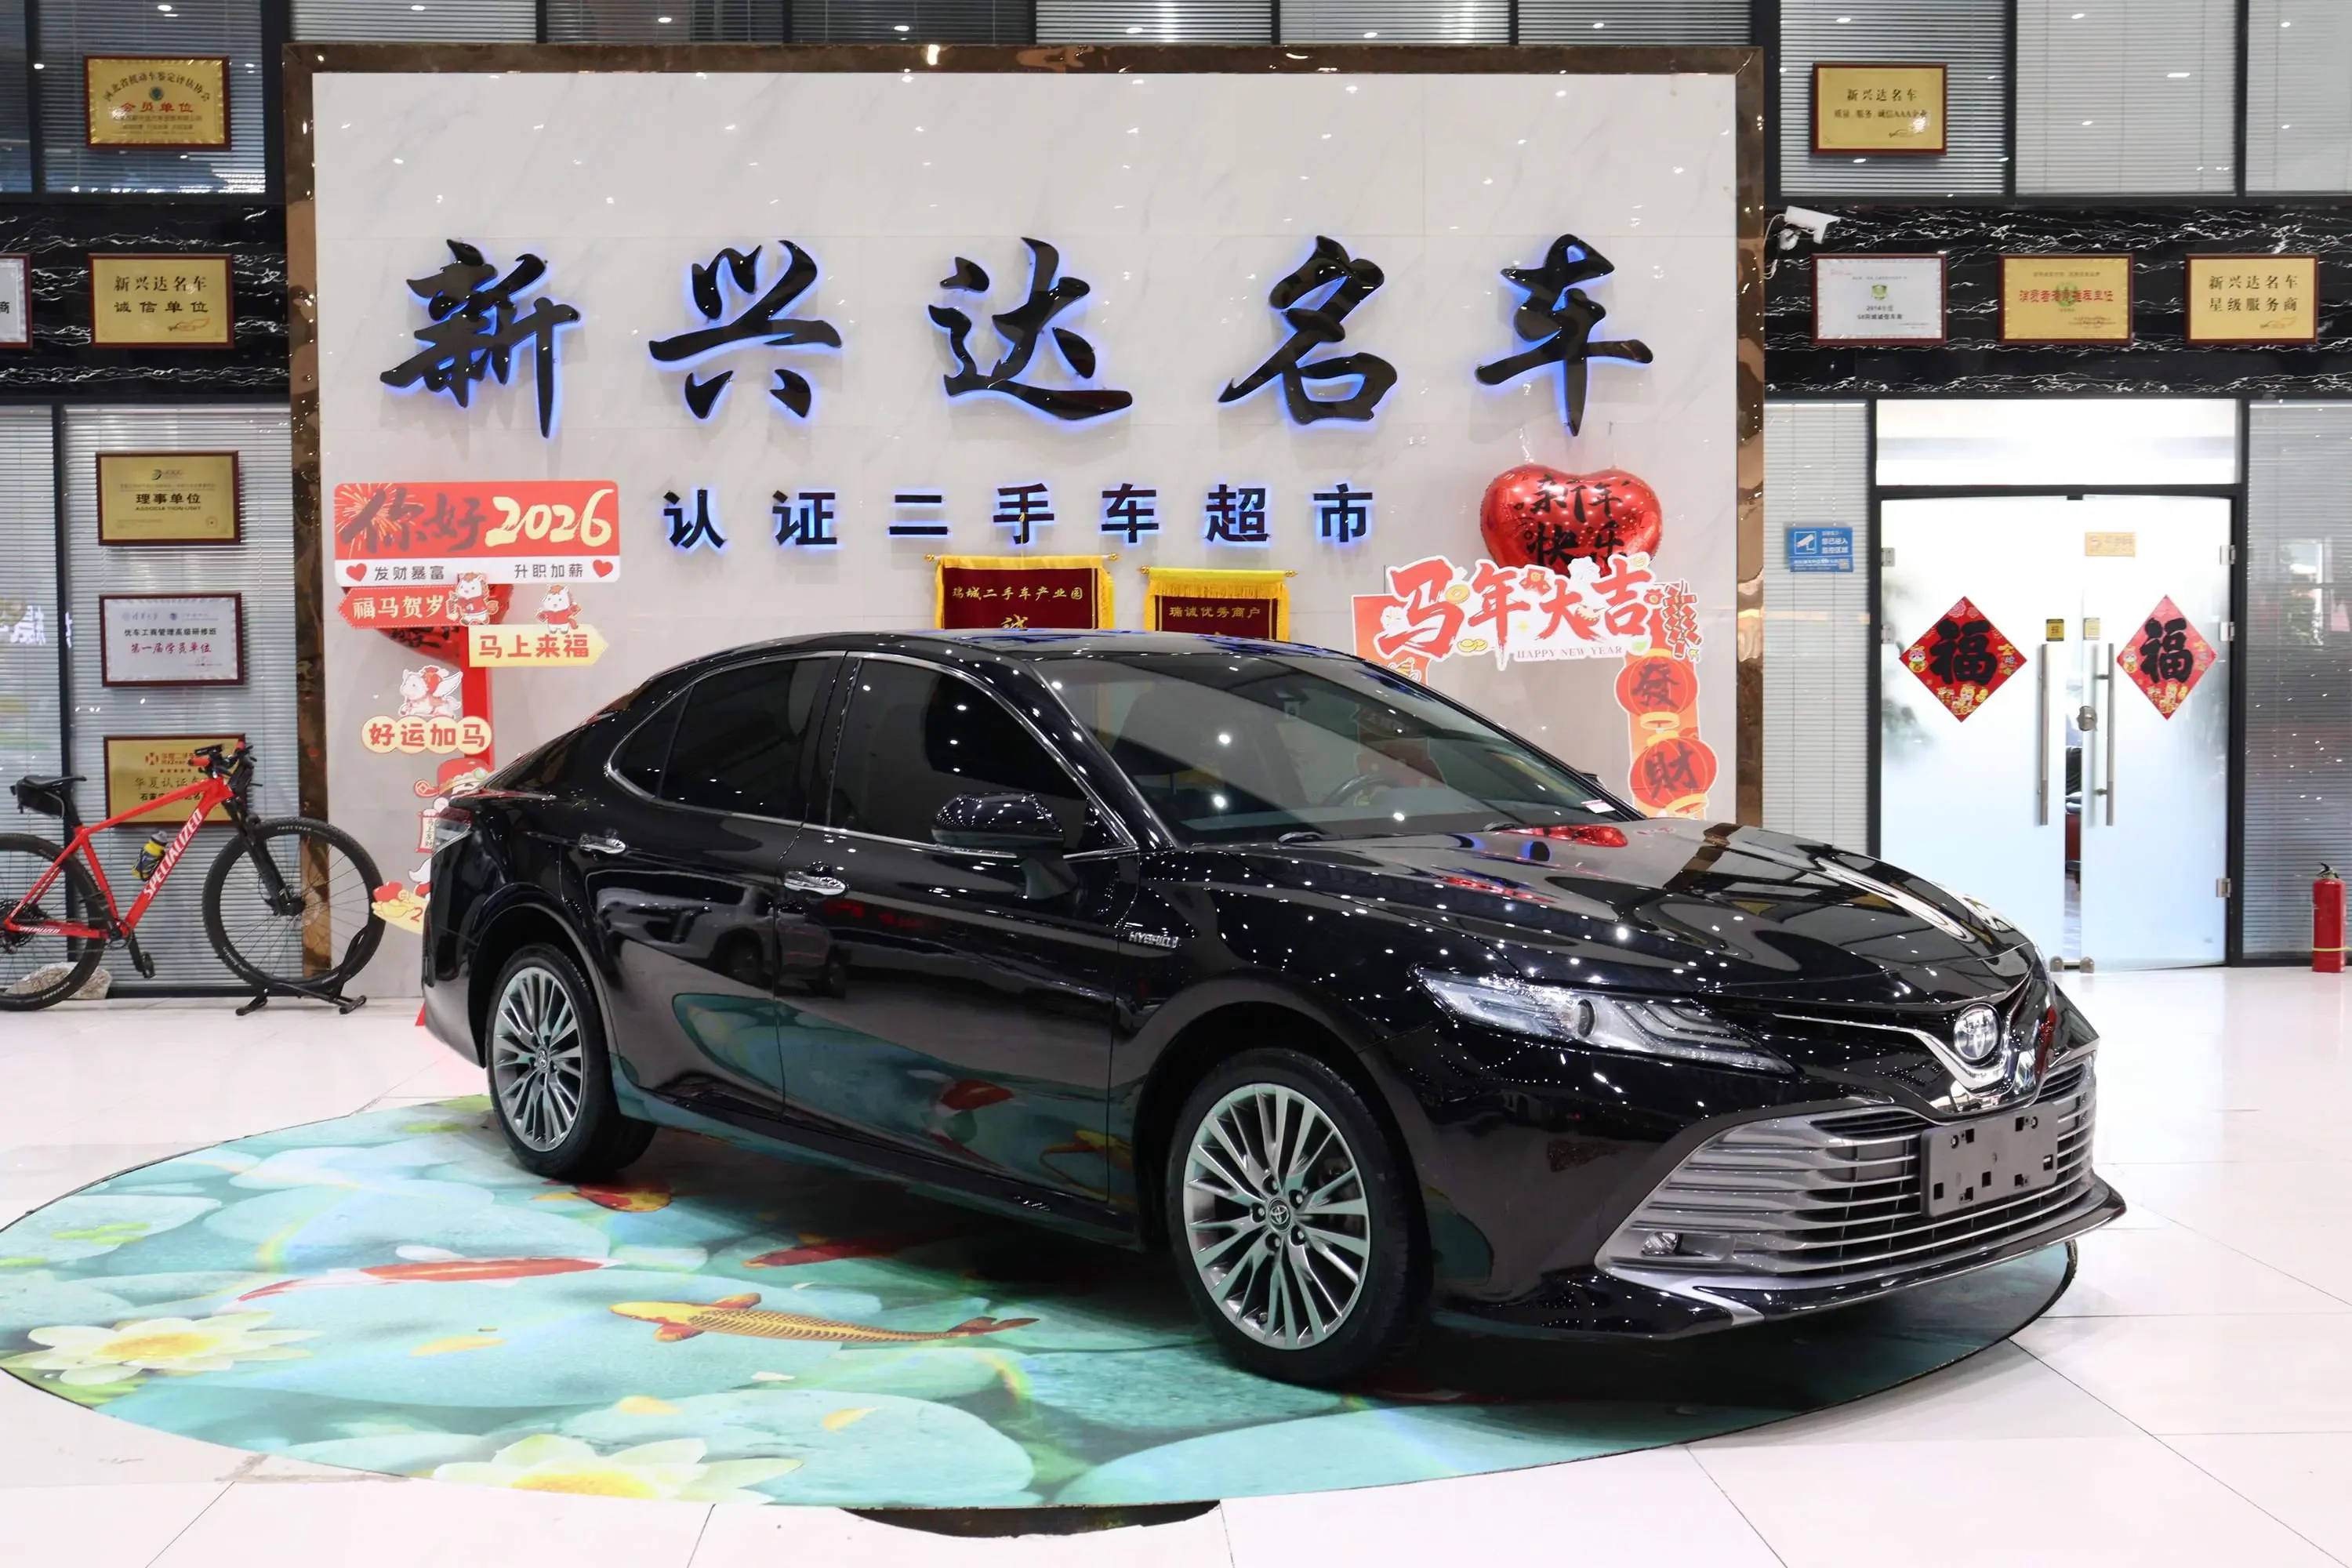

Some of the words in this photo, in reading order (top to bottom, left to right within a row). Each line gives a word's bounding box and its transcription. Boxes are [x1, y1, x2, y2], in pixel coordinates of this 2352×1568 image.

[1846, 88, 1918, 101] 新兴达名车
[120, 102, 194, 113] 会员单位
[114, 276, 208, 292] 新兴达名车
[2209, 274, 2298, 290] 新兴达名车
[114, 301, 208, 313] 诚信单位
[2209, 296, 2298, 312] 星级服务商
[379, 233, 1654, 439] 新兴达名车
[136, 493, 201, 504] 理事单位
[340, 488, 486, 554] 你好
[485, 488, 615, 547] 2026
[664, 483, 1373, 549] 认证二手车超市
[375, 564, 445, 581] 发财暴富
[514, 563, 584, 579] 升职加薪
[352, 595, 444, 620] 福马贺岁
[1379, 558, 1651, 655] 马年大吉
[131, 642, 212, 654] 第一届学员单位
[478, 633, 590, 659] 马上来福
[1517, 649, 1554, 658] HAPPY
[1561, 648, 1584, 656] NEW
[1591, 646, 1622, 655] YEAR
[1929, 619, 1998, 685] 福
[2140, 618, 2194, 684] 福
[368, 723, 485, 748] 好运加马
[143, 808, 203, 900] SPECIALIZED
[1129, 931, 1178, 948] HYBRID
